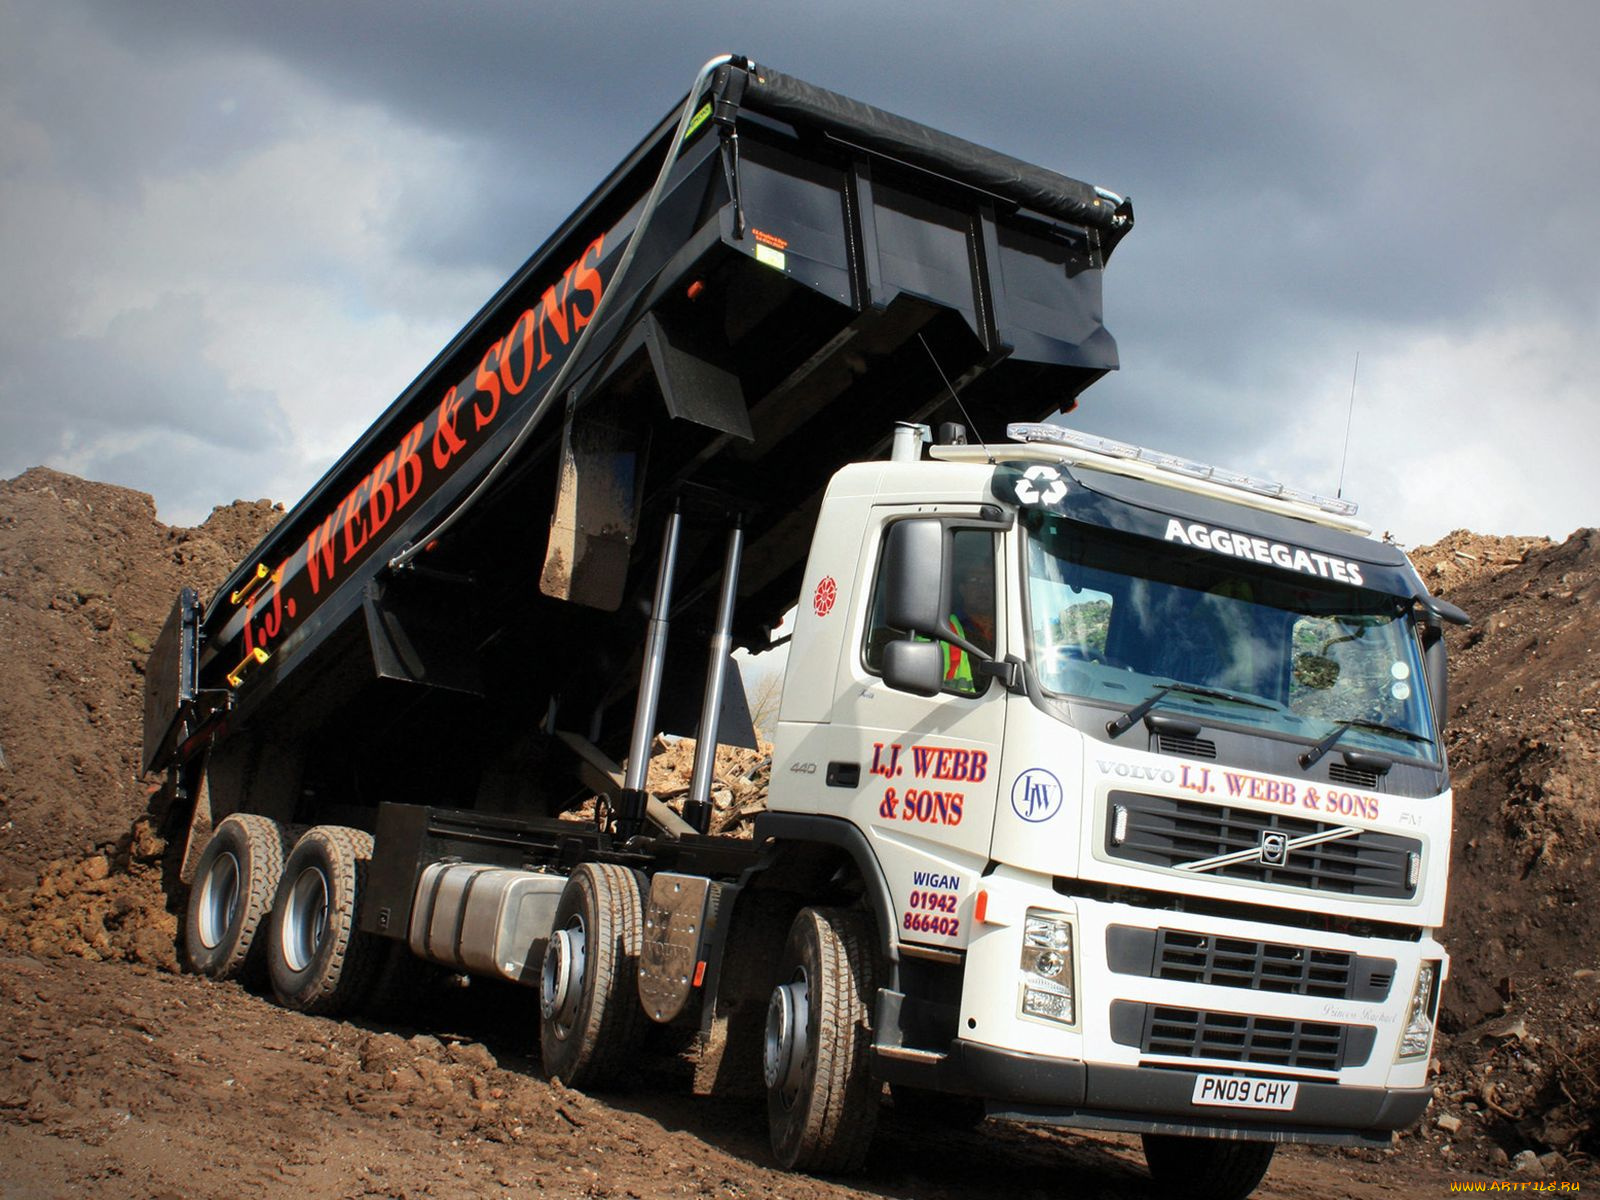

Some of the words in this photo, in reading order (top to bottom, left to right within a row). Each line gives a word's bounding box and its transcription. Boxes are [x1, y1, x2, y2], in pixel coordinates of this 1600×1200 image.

[306, 421, 424, 594] WEBB
[432, 386, 467, 469] &
[474, 233, 605, 432] SONS
[1164, 519, 1364, 586] AGGREGATES
[790, 762, 817, 774] 440
[911, 745, 988, 783] WEBB
[1096, 760, 1175, 783] VOLVO
[879, 787, 899, 819] &
[902, 788, 964, 826] SONS
[1223, 772, 1296, 805] WEBB
[1303, 786, 1321, 810] &
[1326, 790, 1379, 820] SONS
[913, 871, 960, 890] WIGAN
[910, 890, 957, 913] 01942
[903, 912, 960, 936] 866402
[1201, 1078, 1251, 1101] PN09
[1254, 1082, 1290, 1104] CHY
